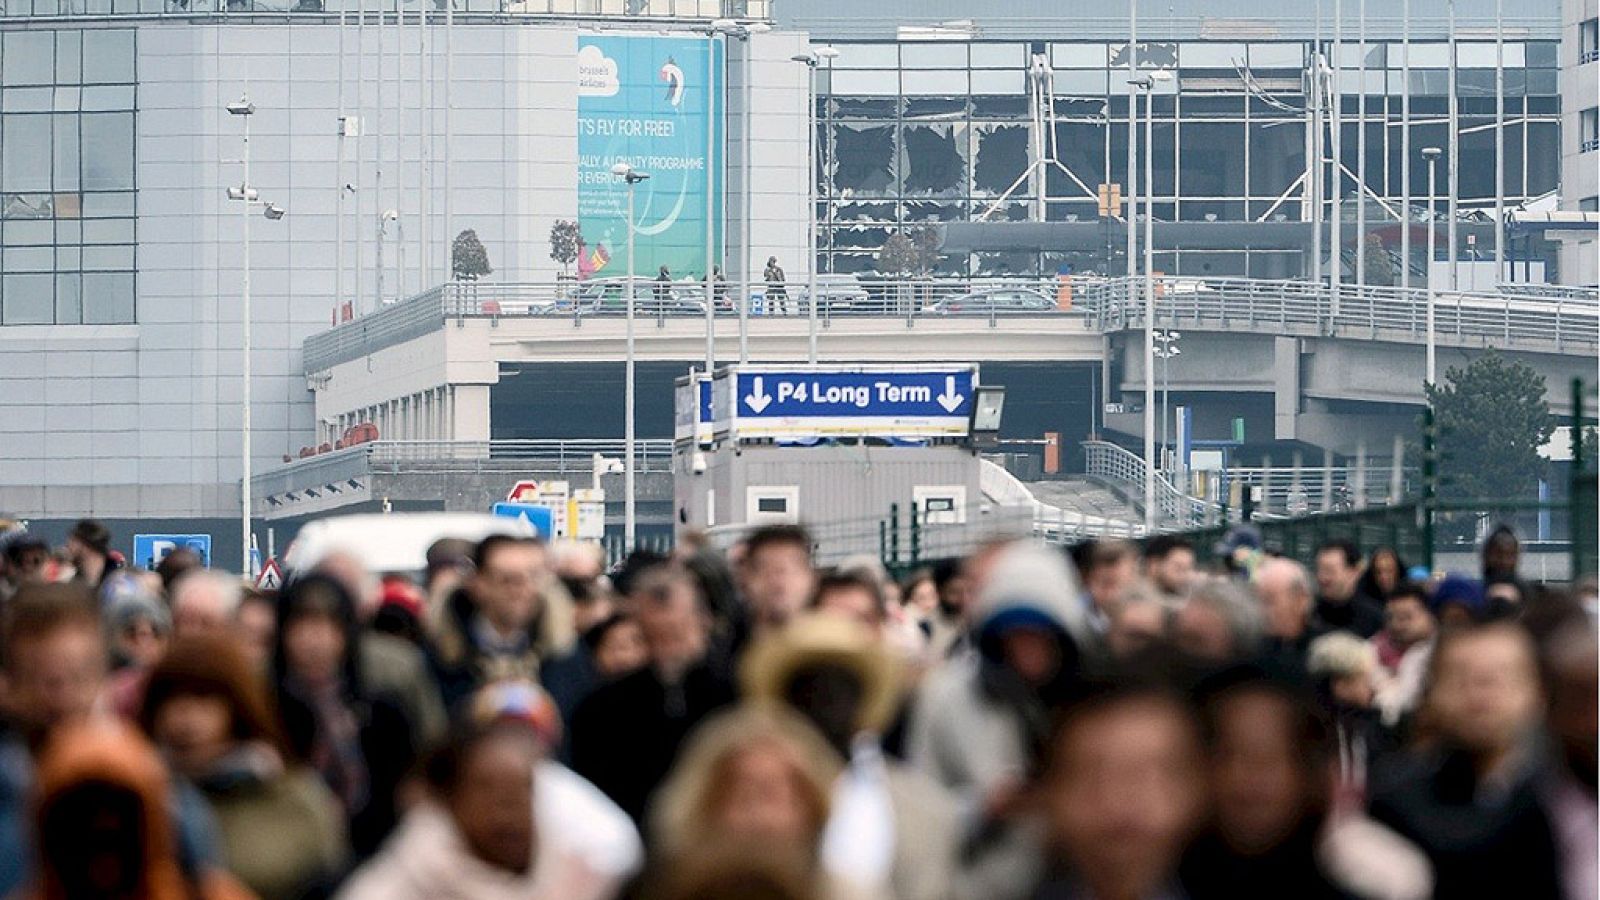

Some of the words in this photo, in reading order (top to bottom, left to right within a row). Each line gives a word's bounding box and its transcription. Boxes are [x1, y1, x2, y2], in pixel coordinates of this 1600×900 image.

[597, 119, 616, 136] FLY
[618, 119, 643, 137] FOR
[644, 120, 675, 137] FREE!
[649, 156, 704, 170] PROGRAMME
[778, 381, 808, 404] P4
[812, 381, 870, 408] Long
[875, 381, 931, 403] Term
